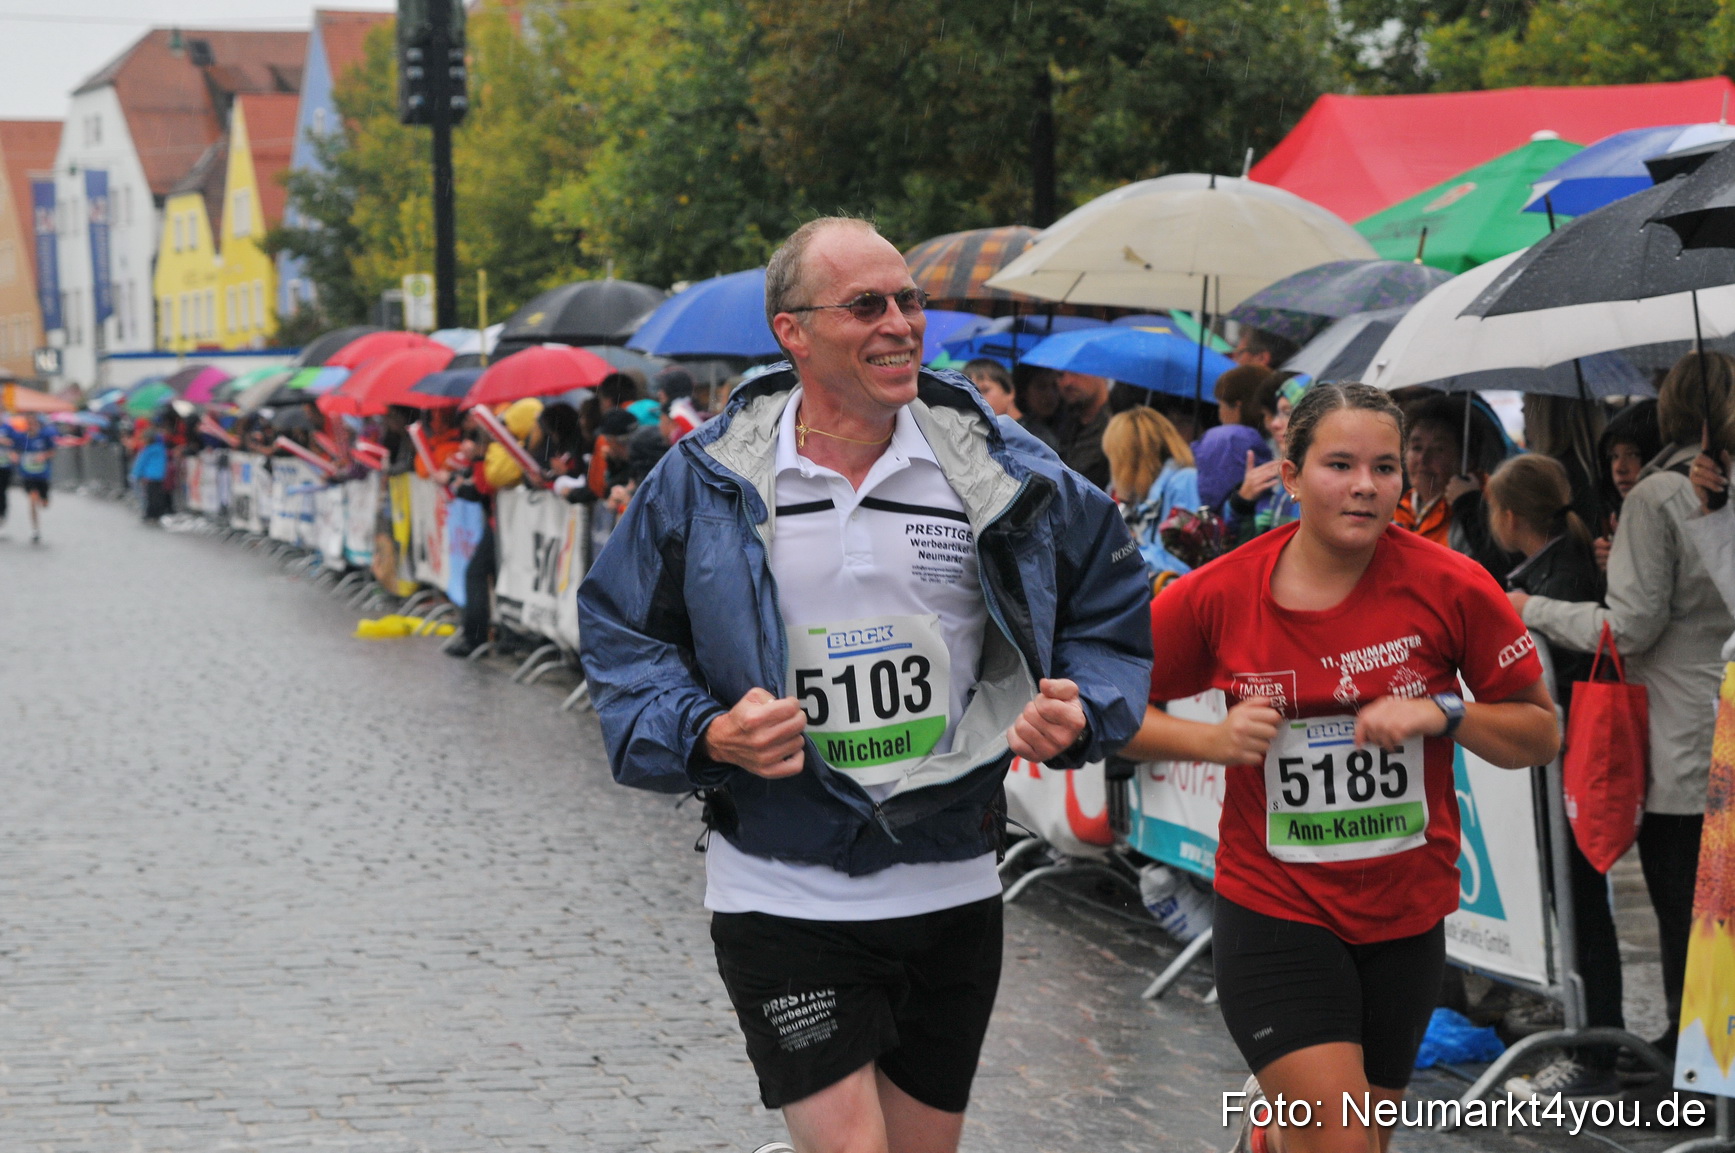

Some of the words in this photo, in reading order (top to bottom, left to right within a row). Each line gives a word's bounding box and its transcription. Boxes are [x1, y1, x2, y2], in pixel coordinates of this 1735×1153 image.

[905, 523, 975, 543] PRESTIGE
[910, 538, 970, 555] Werbeartikel
[918, 550, 963, 564] Neumarkt
[827, 625, 894, 649] BOCK
[1340, 635, 1421, 665] NEUMARKTER
[1340, 650, 1410, 676] STADTLAUF
[795, 655, 932, 727] 5103
[1240, 682, 1284, 696] IMMER
[1307, 721, 1355, 739] BOC
[827, 729, 911, 762] Michael
[1279, 746, 1408, 807] 5185
[1287, 813, 1408, 841] Ann-Kathirn
[769, 997, 837, 1027] Werbeartikel
